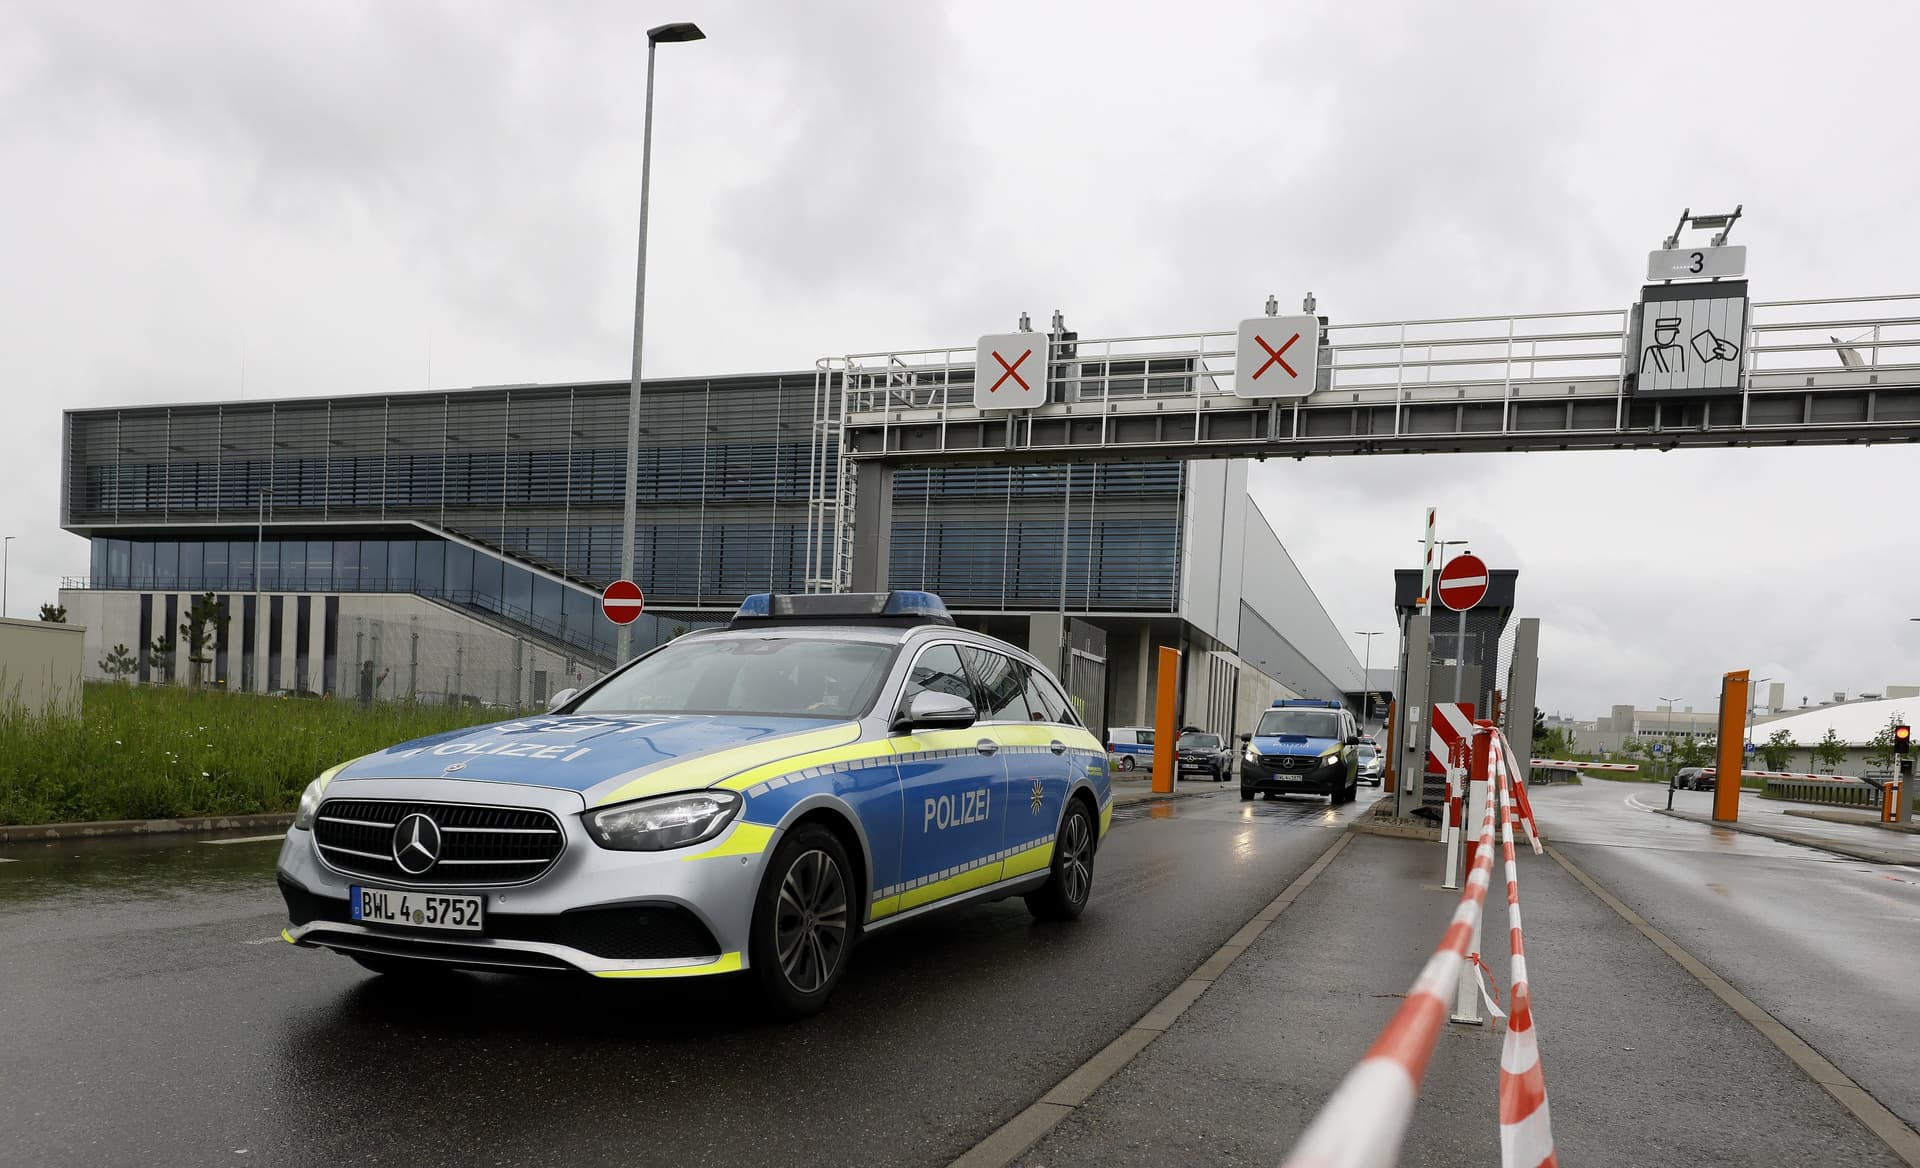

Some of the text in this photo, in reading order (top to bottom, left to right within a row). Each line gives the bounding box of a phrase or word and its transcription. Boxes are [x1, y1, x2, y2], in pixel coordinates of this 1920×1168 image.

[1690, 251, 1704, 274] 3
[923, 788, 991, 833] POLIZEI
[362, 891, 480, 927] BWL 4 5752
